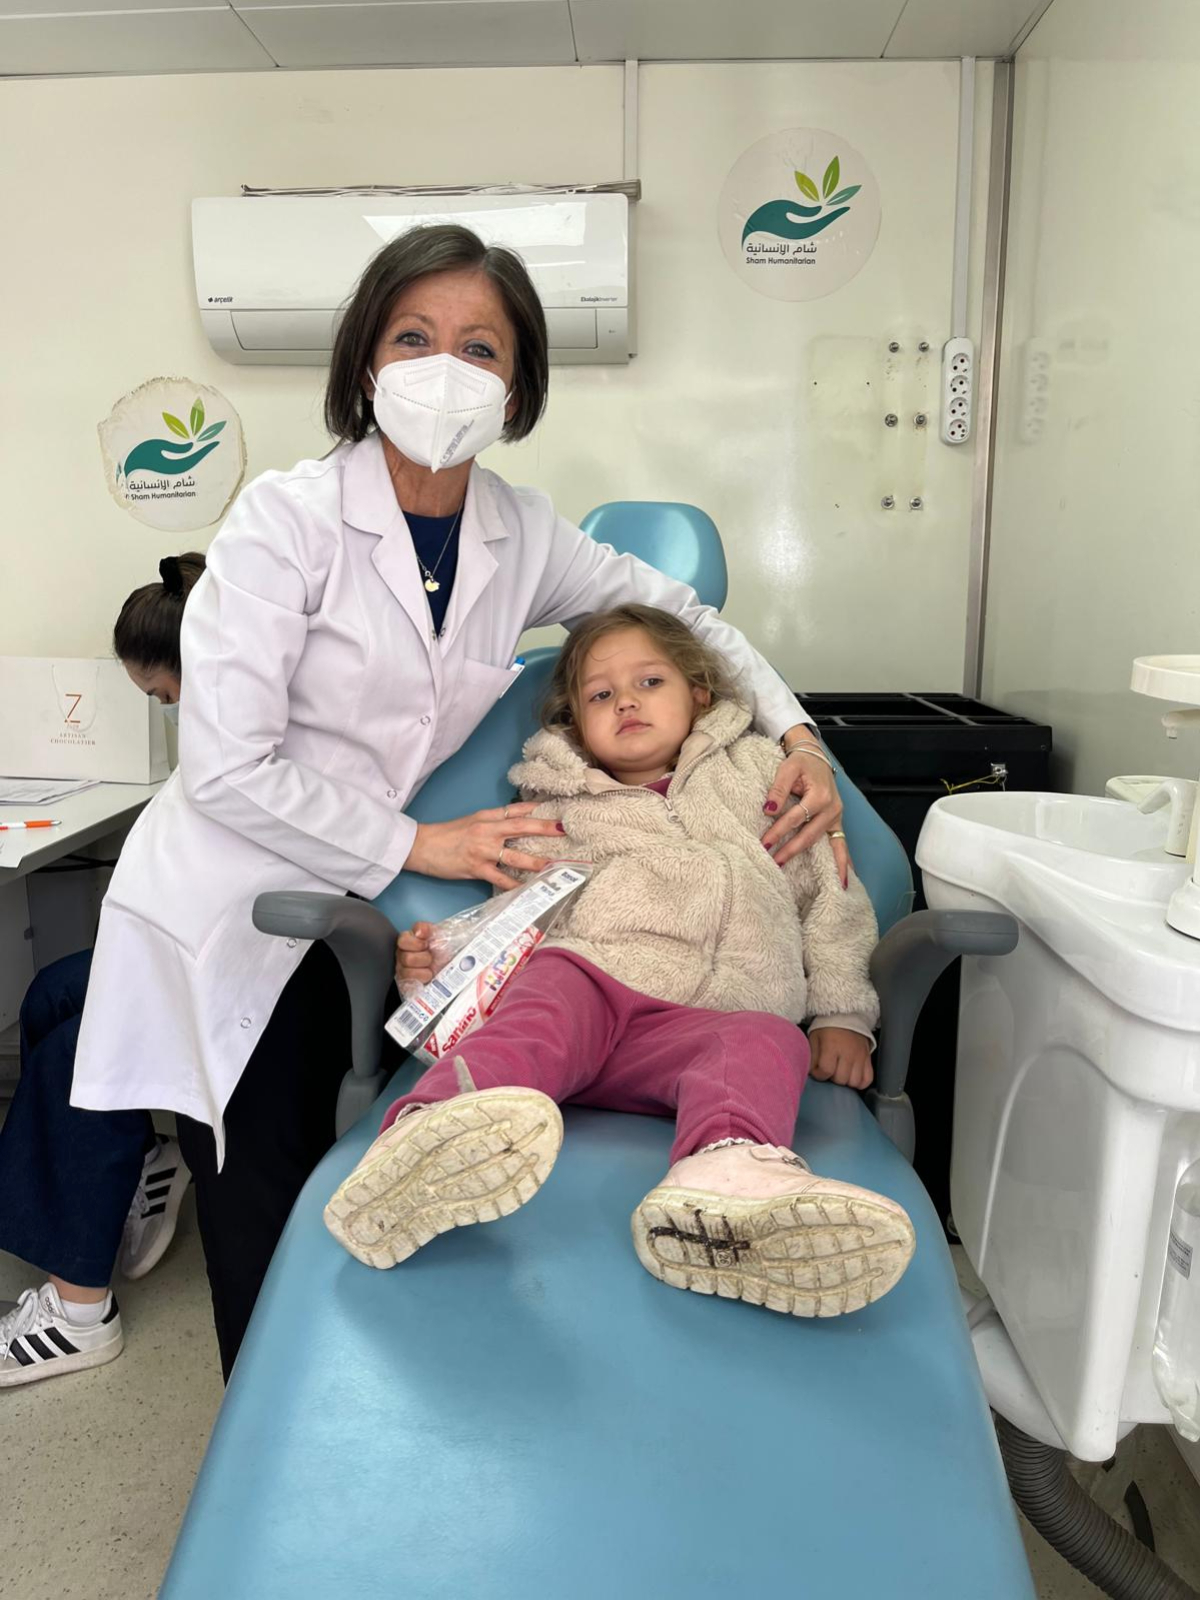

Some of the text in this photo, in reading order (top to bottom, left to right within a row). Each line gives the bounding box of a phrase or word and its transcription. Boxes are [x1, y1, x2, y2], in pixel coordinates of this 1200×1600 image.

[746, 241, 817, 255] شام الإنسانية
[768, 257, 816, 265] Humanitarian
[129, 475, 195, 492] شام الإنسانية
[151, 491, 196, 500] Humanitarian
[64, 693, 82, 723] Z
